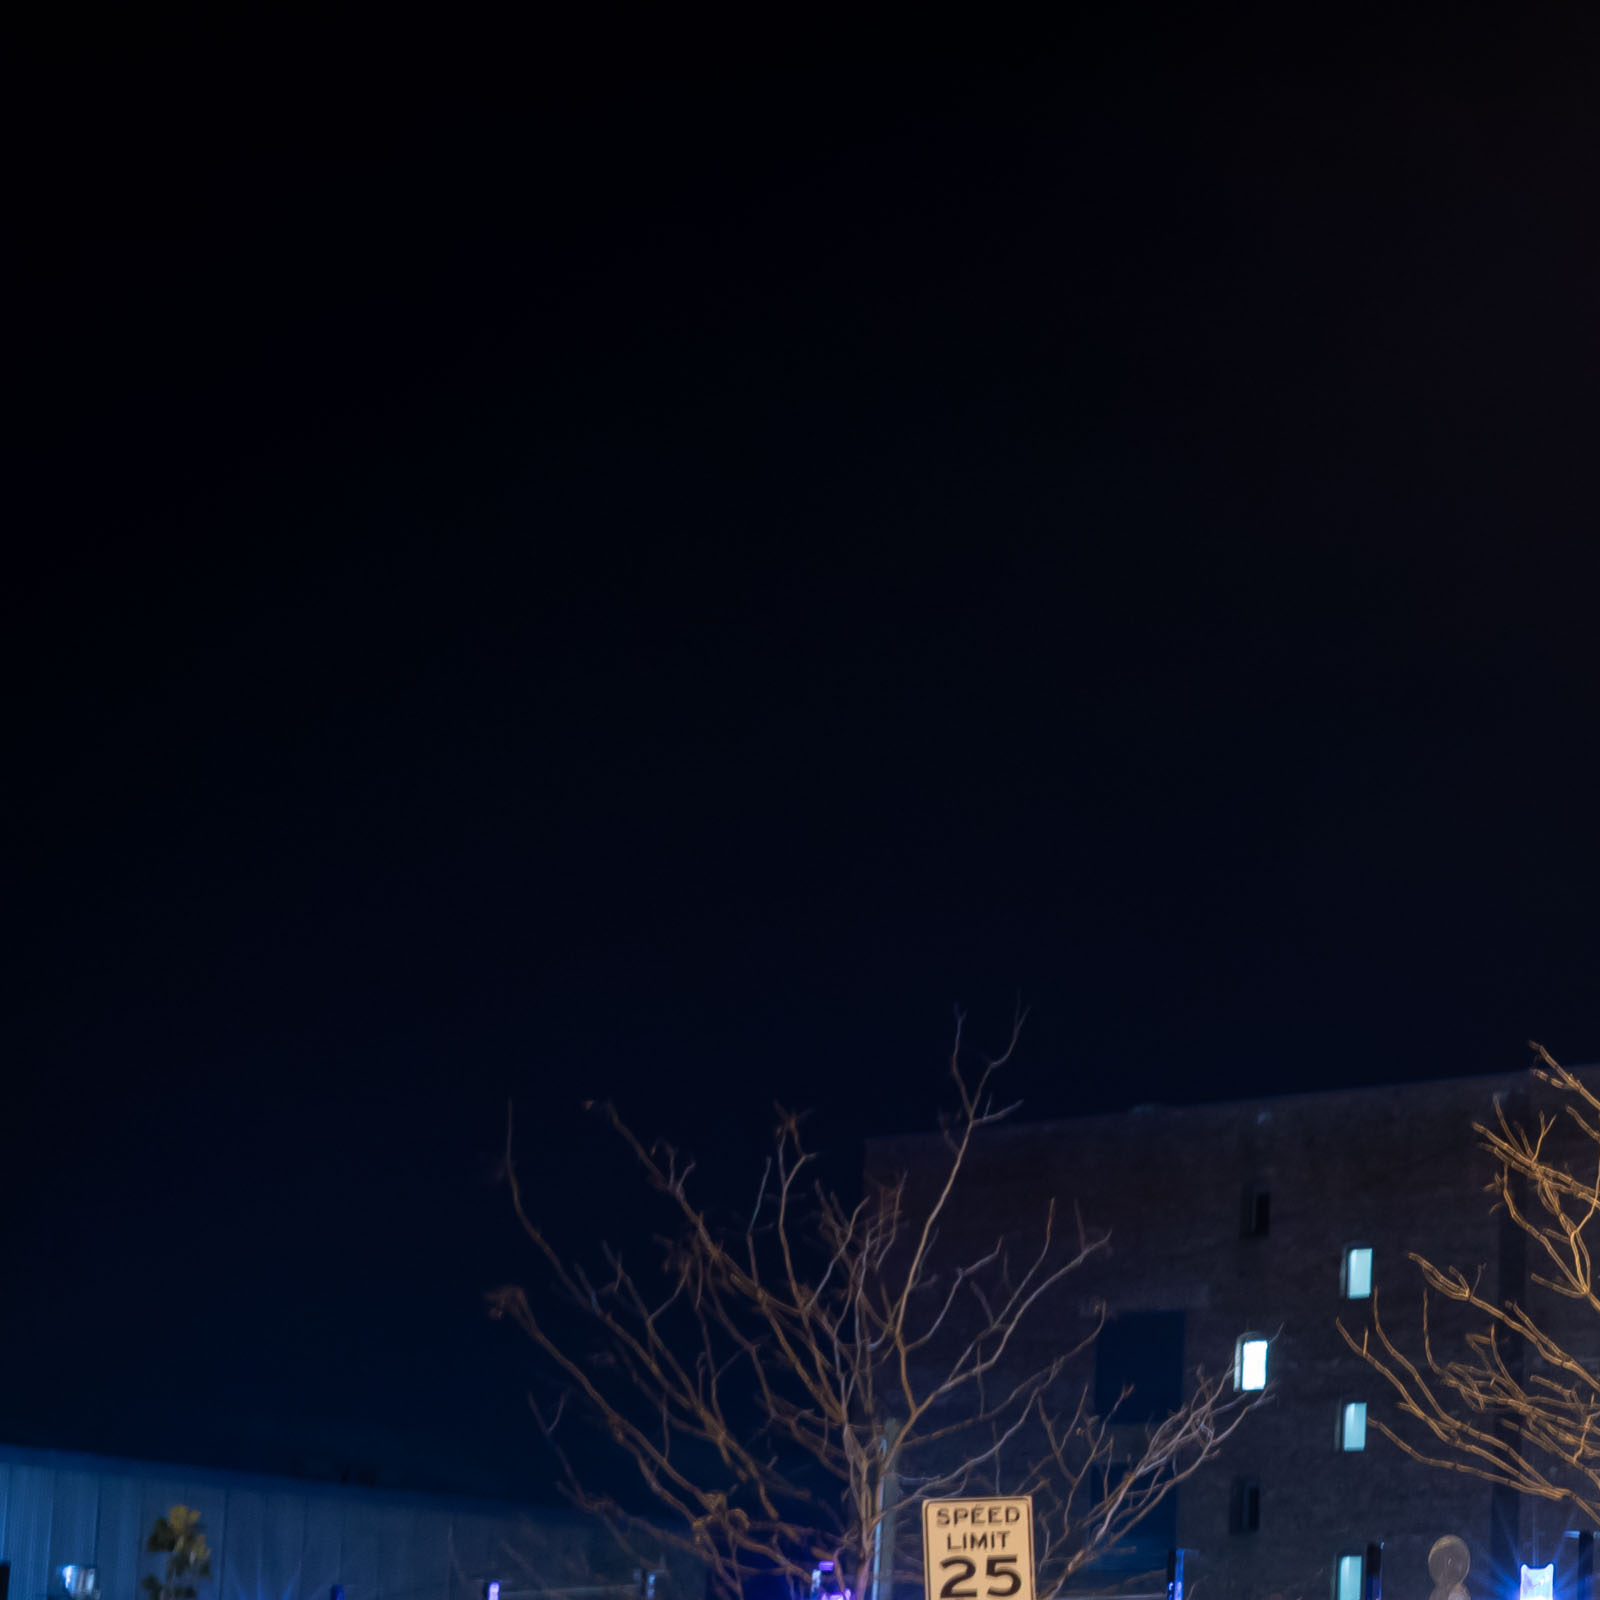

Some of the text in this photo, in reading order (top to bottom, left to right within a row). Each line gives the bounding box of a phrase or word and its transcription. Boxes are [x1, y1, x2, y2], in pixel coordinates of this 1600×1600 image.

[936, 1506, 1020, 1527] SPEED
[947, 1531, 1011, 1551] LIMIT
[940, 1555, 1022, 1598] 25
